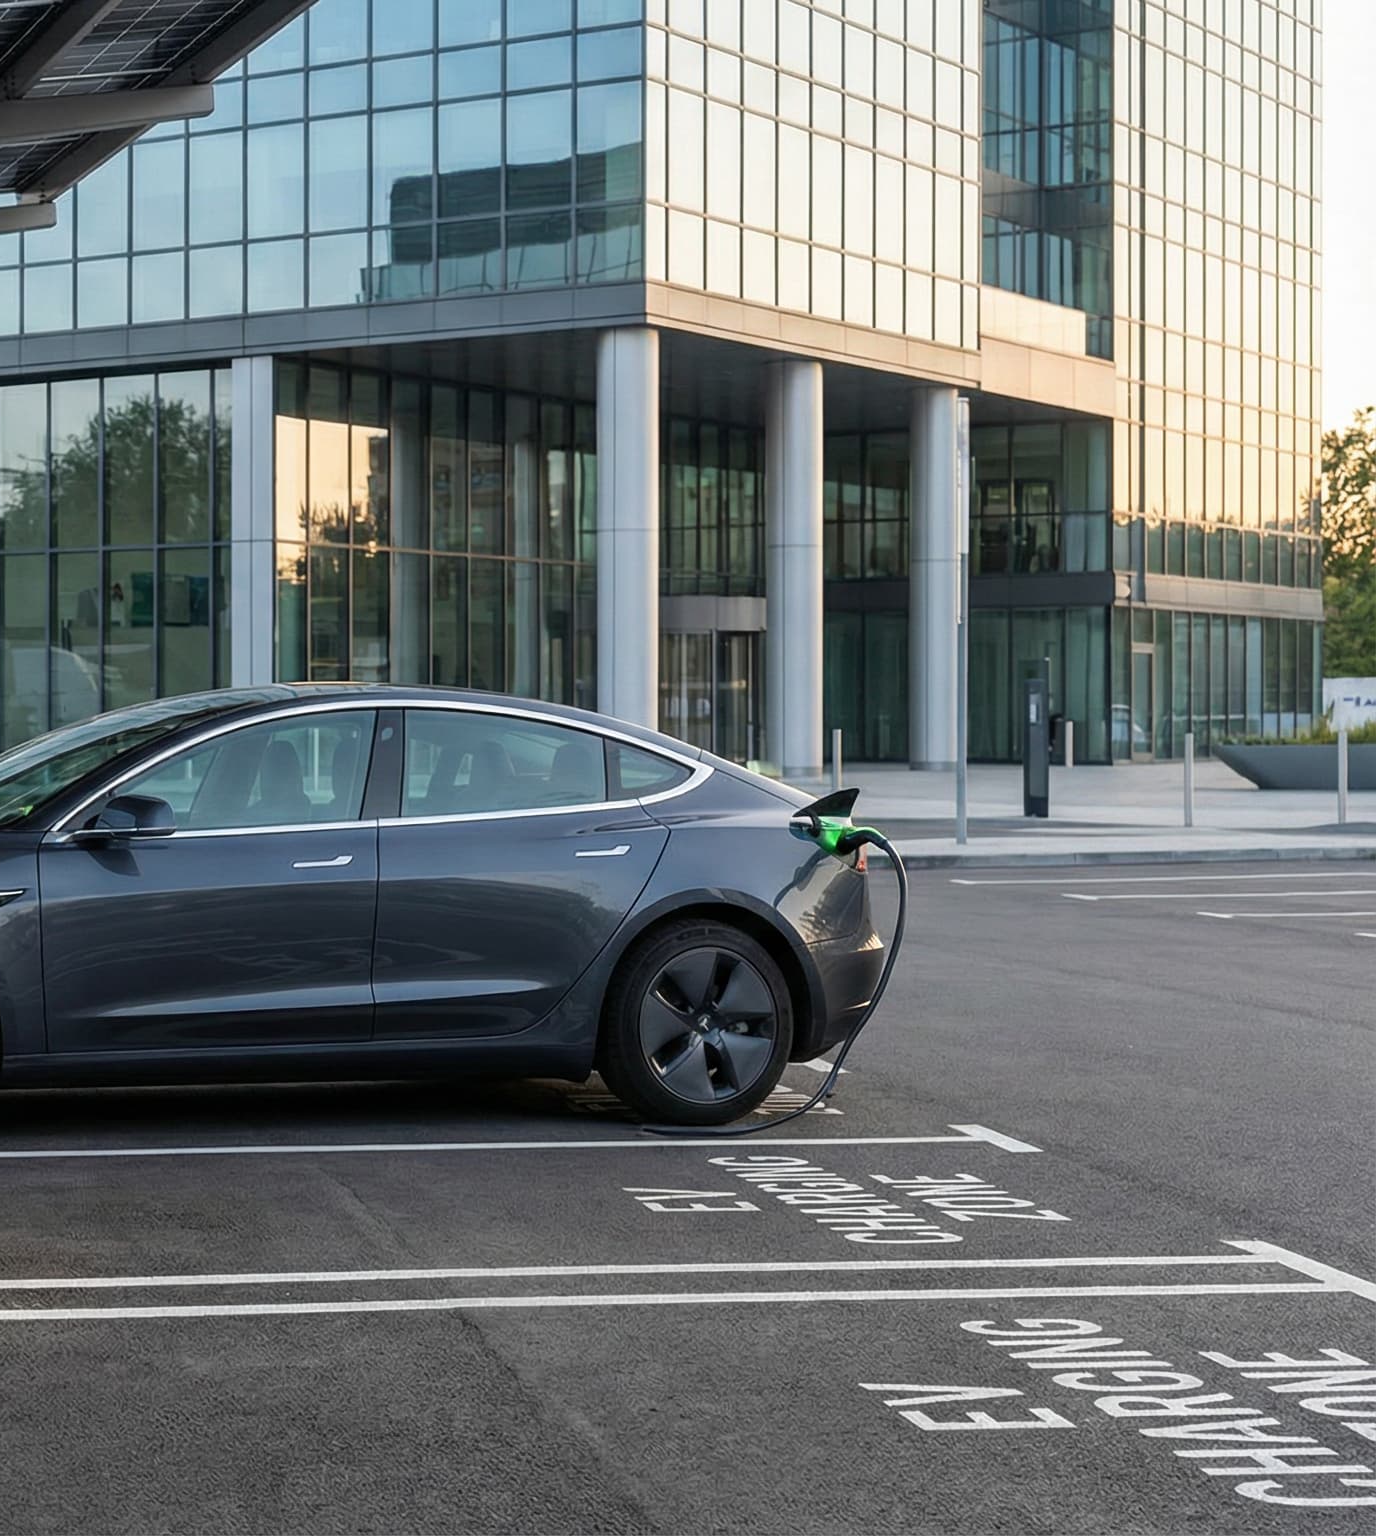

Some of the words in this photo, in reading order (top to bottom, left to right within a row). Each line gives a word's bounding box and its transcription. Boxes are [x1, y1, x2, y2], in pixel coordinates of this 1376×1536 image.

[622, 1187, 761, 1212] EV
[708, 1156, 963, 1244] CHARGING
[869, 1173, 1072, 1221] ZONE
[858, 1383, 1077, 1431] EV
[959, 1318, 1376, 1507] CHARGING
